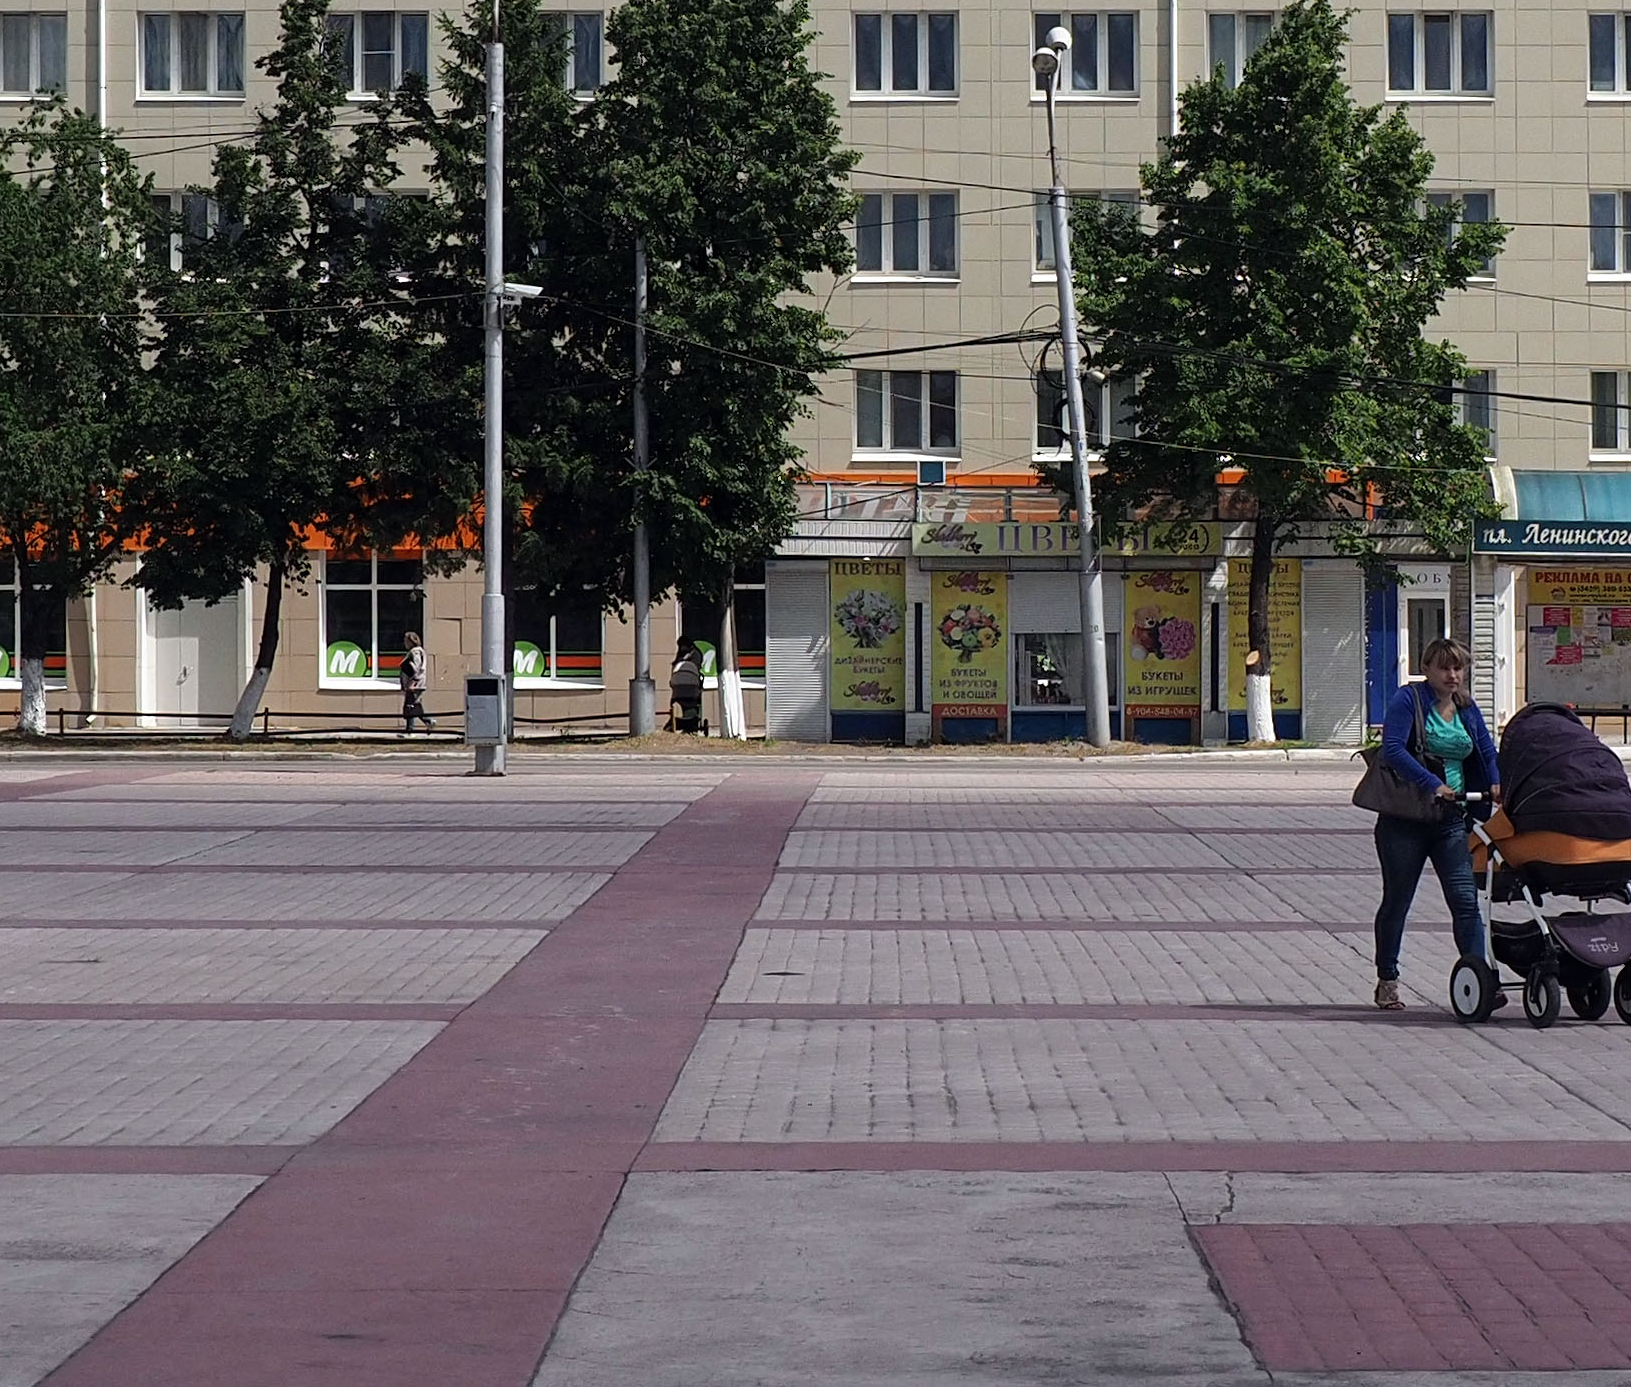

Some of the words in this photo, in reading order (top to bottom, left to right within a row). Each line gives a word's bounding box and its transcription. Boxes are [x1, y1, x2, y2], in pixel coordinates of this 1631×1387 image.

[996, 524, 1150, 552] ЦВЕЫ
[1482, 529, 1512, 544] пл.
[834, 561, 903, 577] ЦВЕТЫ
[1535, 572, 1600, 584] РЕКЛАМА
[1604, 572, 1622, 584] НА
[853, 666, 885, 674] БУКЕТЫ
[951, 668, 987, 677] БУКЕТЫ
[1141, 671, 1183, 681] БУКЕТЫ
[939, 679, 951, 688] ИЗ
[955, 679, 998, 688] ФРУКТОВ
[953, 690, 997, 700] ОВОЩЕЙ
[1127, 686, 1142, 695] ИЗ
[1145, 686, 1197, 696] ИГРУШЕК
[942, 708, 997, 716] ДОСТАВКА
